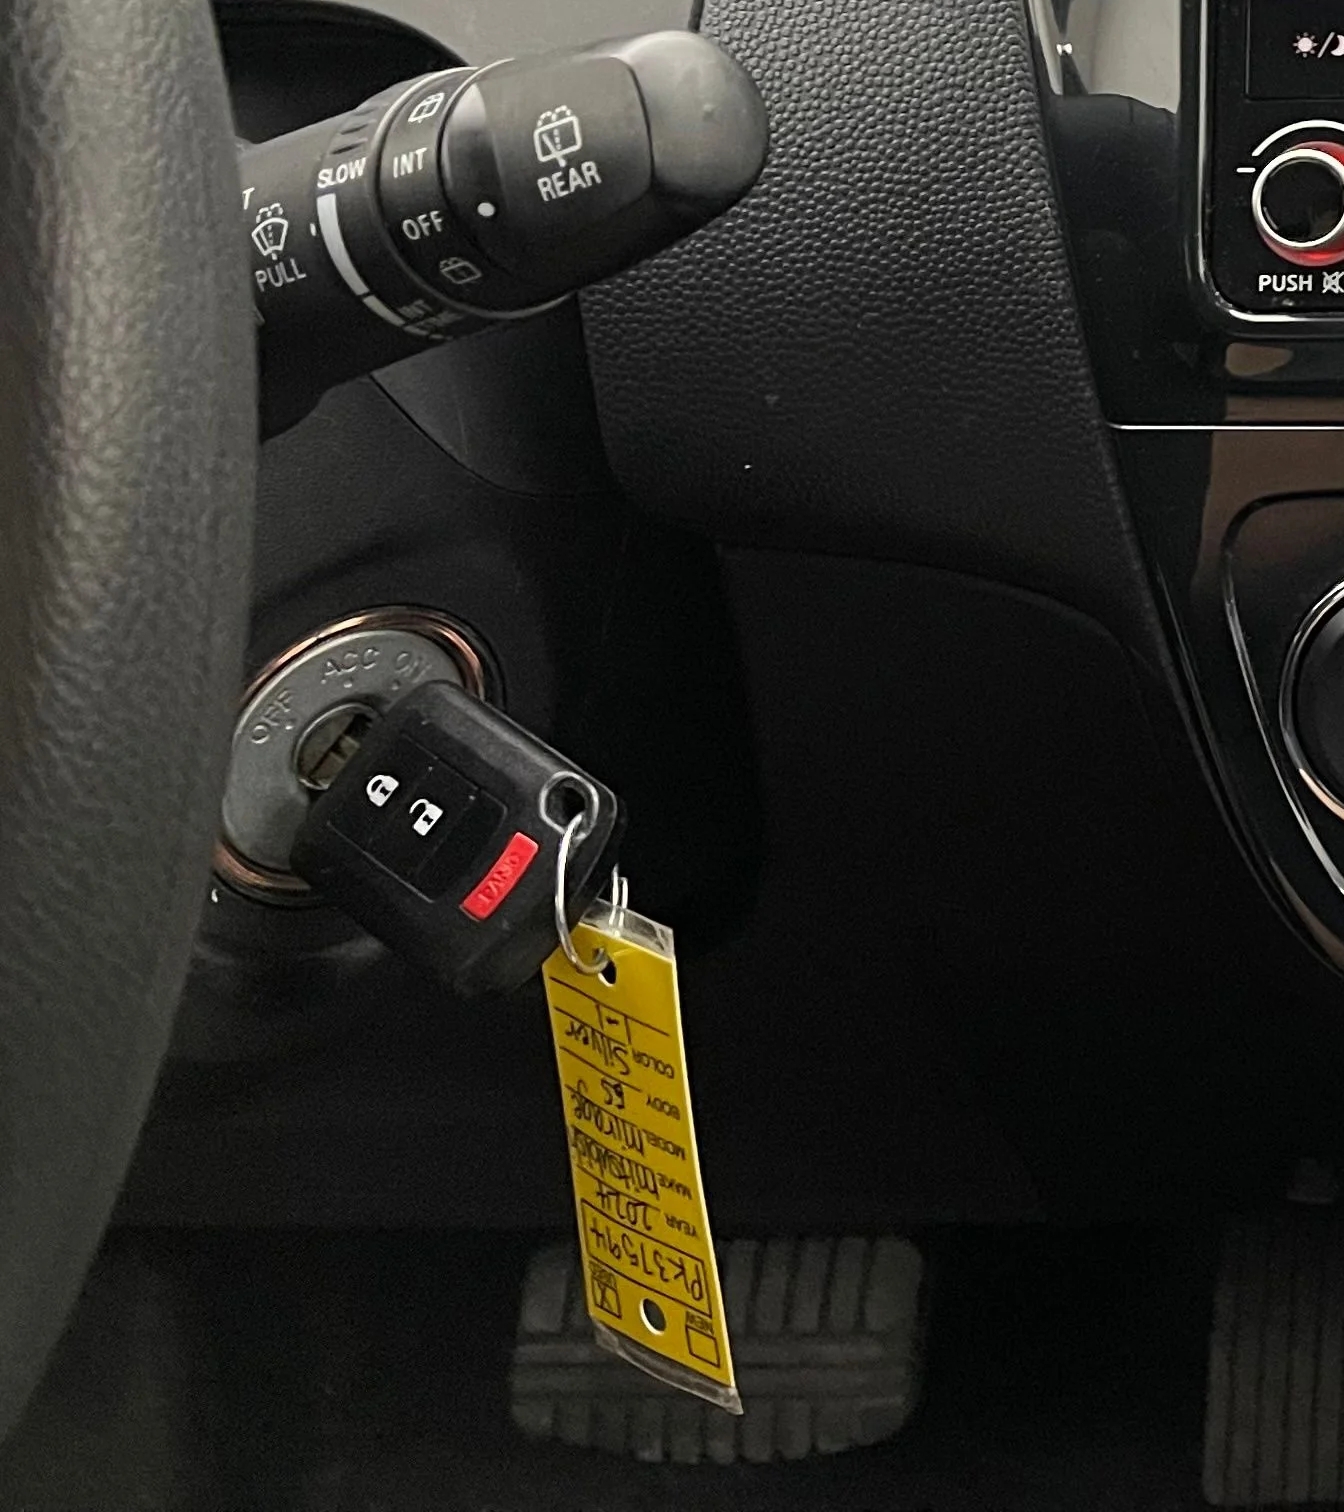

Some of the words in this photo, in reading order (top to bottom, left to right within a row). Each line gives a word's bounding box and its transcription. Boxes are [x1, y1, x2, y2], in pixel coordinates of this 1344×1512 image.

[316, 156, 367, 189] SLOW
[392, 147, 428, 178] INT
[537, 160, 602, 202] REAR
[402, 209, 445, 241] OFF
[254, 257, 308, 293] PULL
[1258, 273, 1313, 292] PUSH
[321, 648, 381, 677] ACC
[251, 690, 294, 744] OFF
[632, 1047, 675, 1079] COLOR
[646, 1095, 681, 1120] BODY
[641, 1129, 686, 1161] MODEL
[596, 1179, 652, 1231] 2024
[663, 1213, 698, 1239] YEAR
